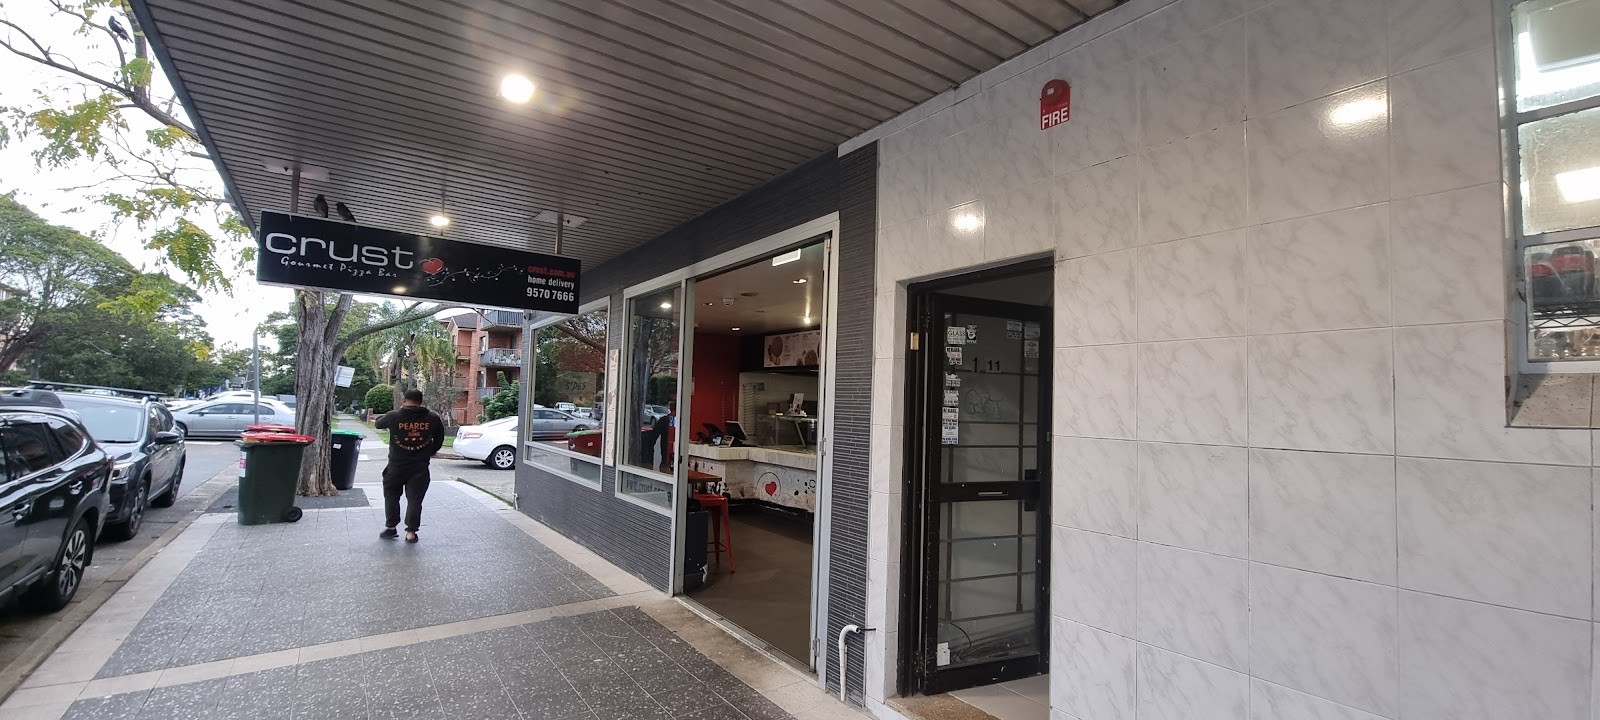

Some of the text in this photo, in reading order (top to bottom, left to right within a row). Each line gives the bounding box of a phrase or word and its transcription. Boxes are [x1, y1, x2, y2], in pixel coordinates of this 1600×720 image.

[1042, 107, 1068, 129] FIRE
[265, 232, 414, 269] crust
[280, 256, 397, 278] Gourmet Pizza Bar
[527, 275, 575, 290] home delivery
[526, 287, 575, 302] 9570 7666
[398, 422, 430, 430] PEARCE
